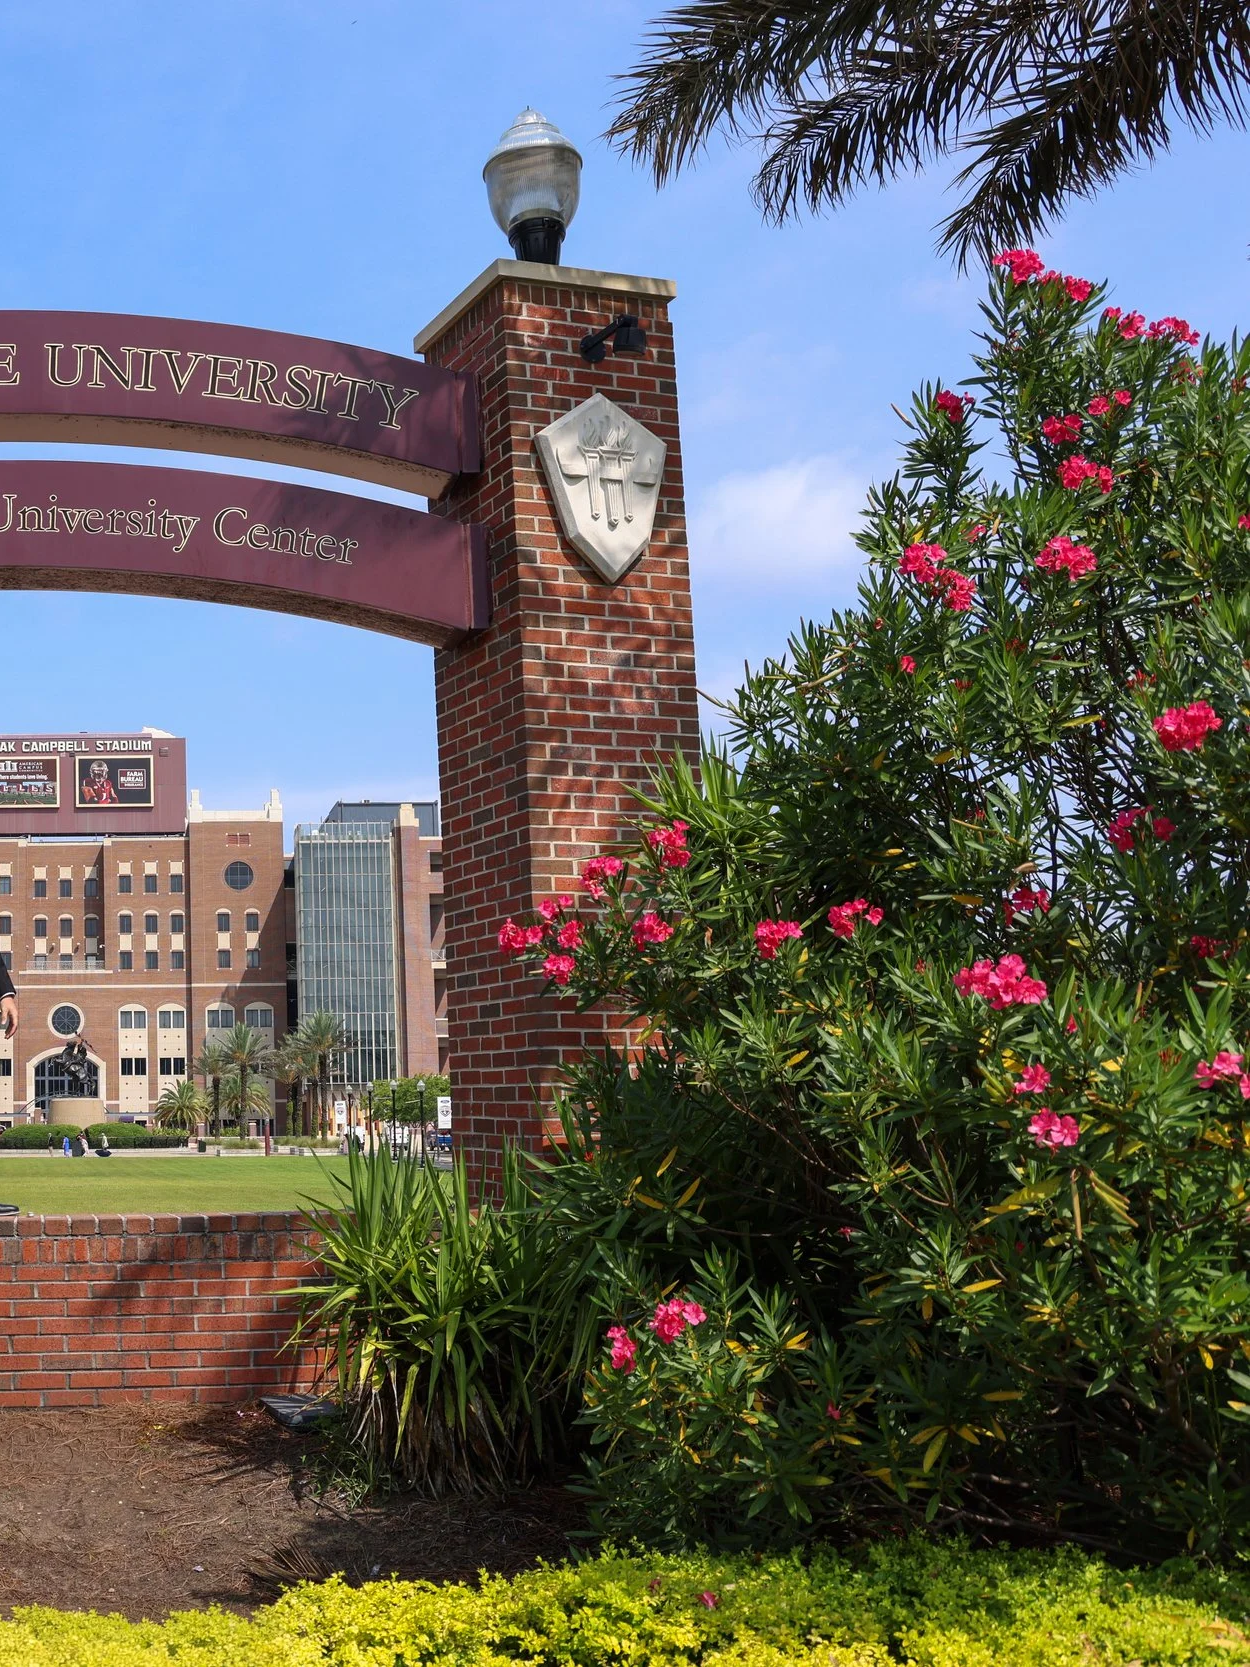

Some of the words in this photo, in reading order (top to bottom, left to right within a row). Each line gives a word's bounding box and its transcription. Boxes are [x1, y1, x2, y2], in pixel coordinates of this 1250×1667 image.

[44, 343, 419, 430] UNIVERSITY
[212, 506, 359, 565] Center
[22, 741, 90, 753] CAMPBELL
[96, 740, 152, 752] STADIUM
